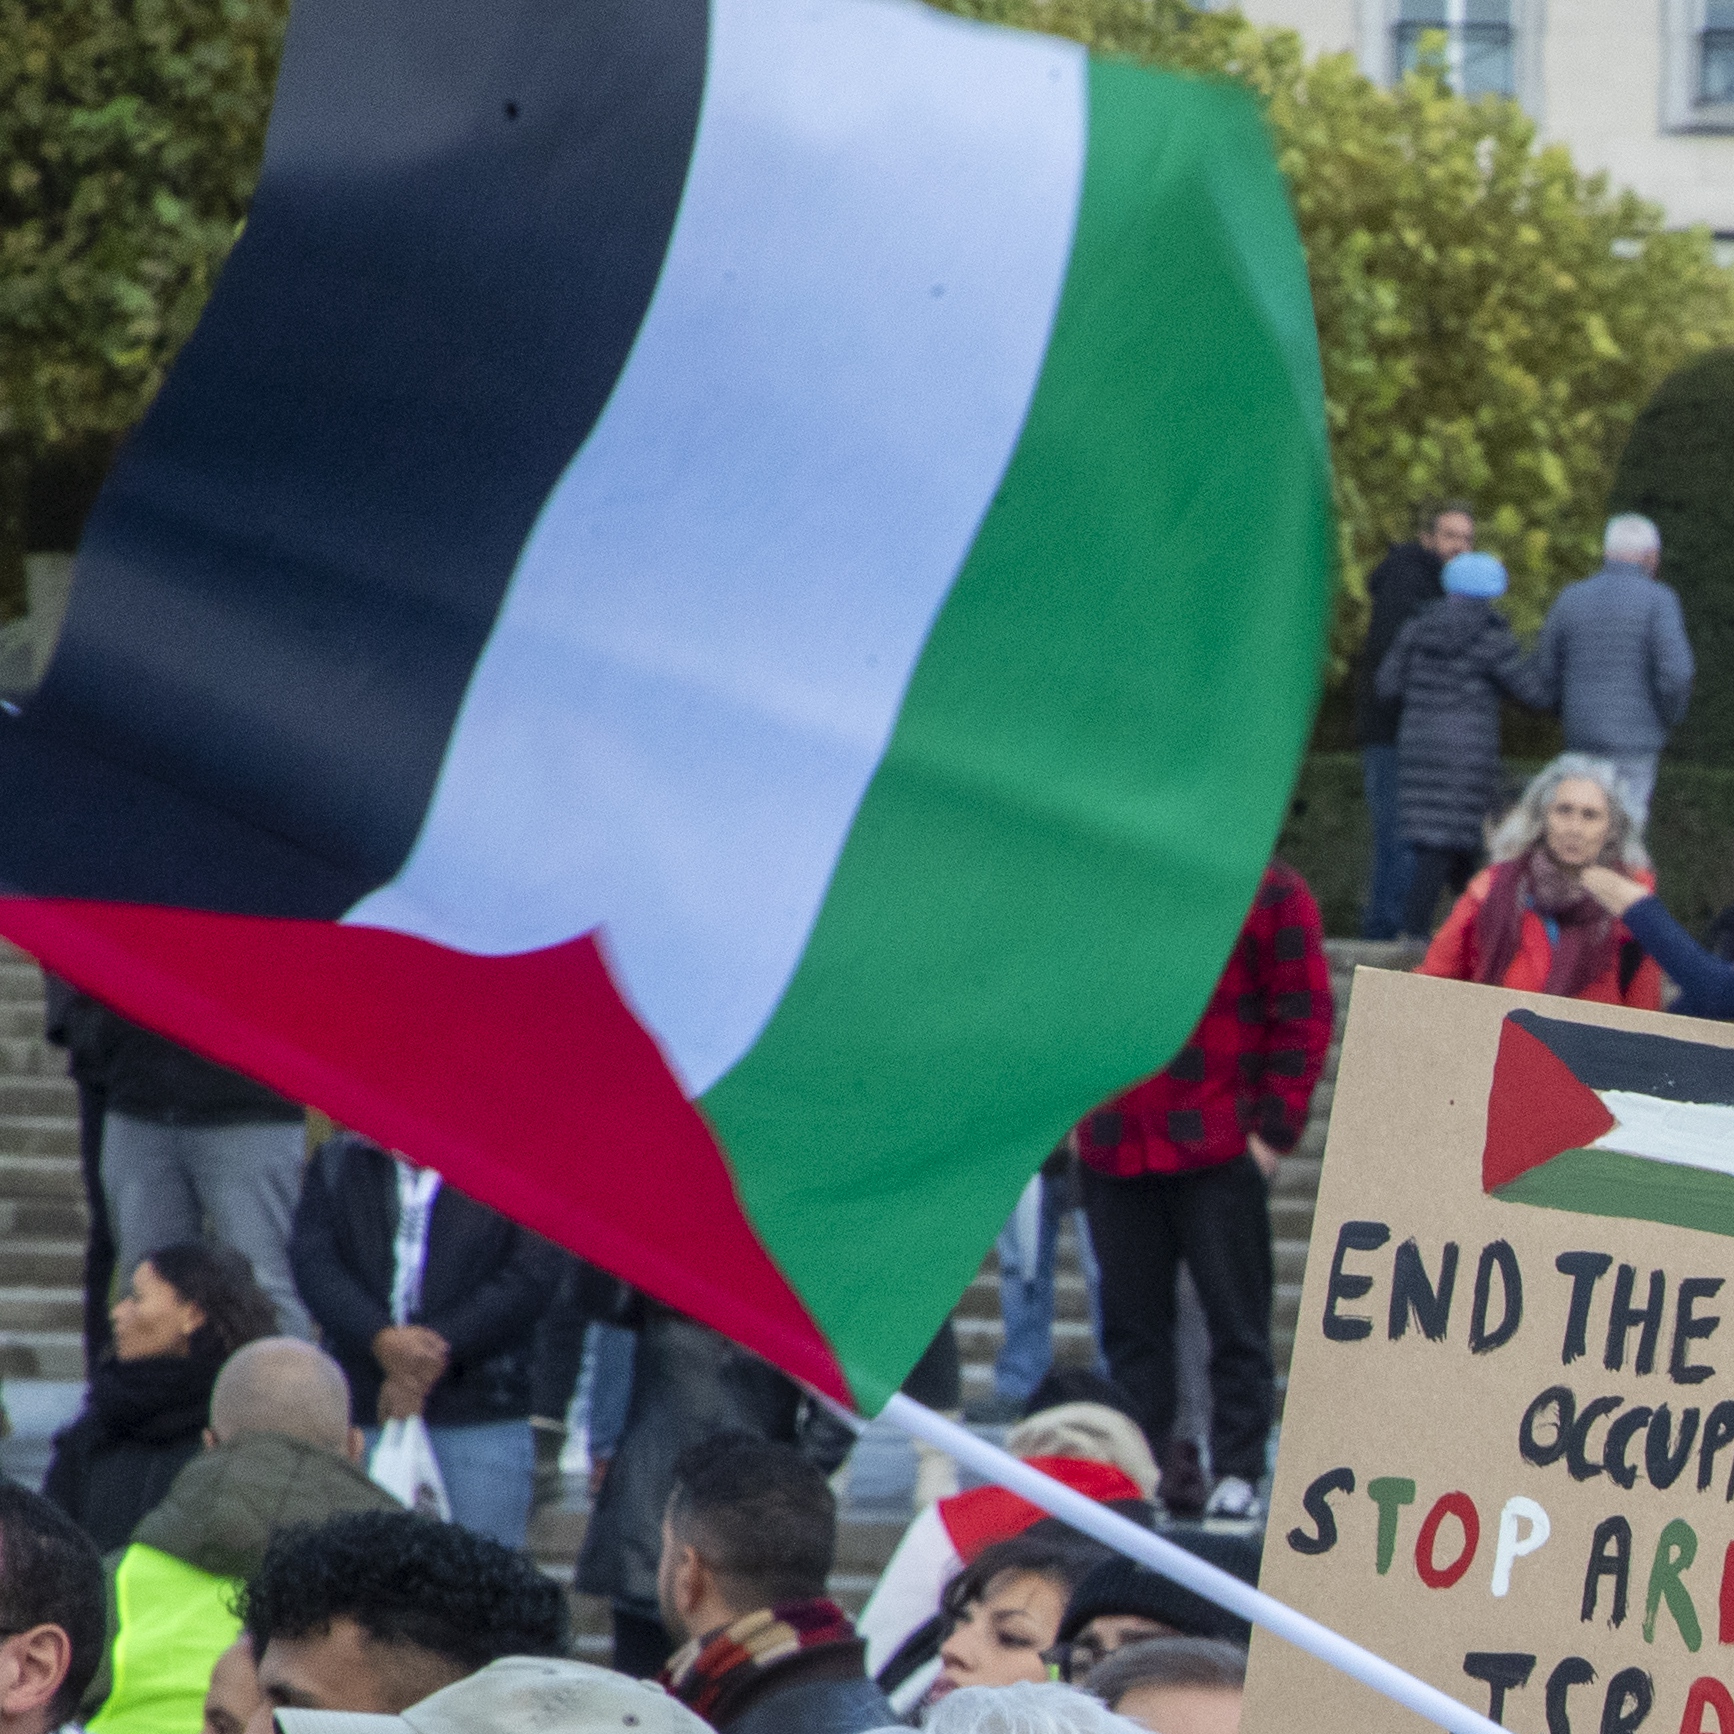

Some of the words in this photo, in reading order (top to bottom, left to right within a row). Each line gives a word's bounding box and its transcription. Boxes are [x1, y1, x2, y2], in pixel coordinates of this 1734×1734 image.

[1322, 1221, 1523, 1354] END
[1555, 1251, 1725, 1386] THE
[1286, 1467, 1550, 1597] STOP
